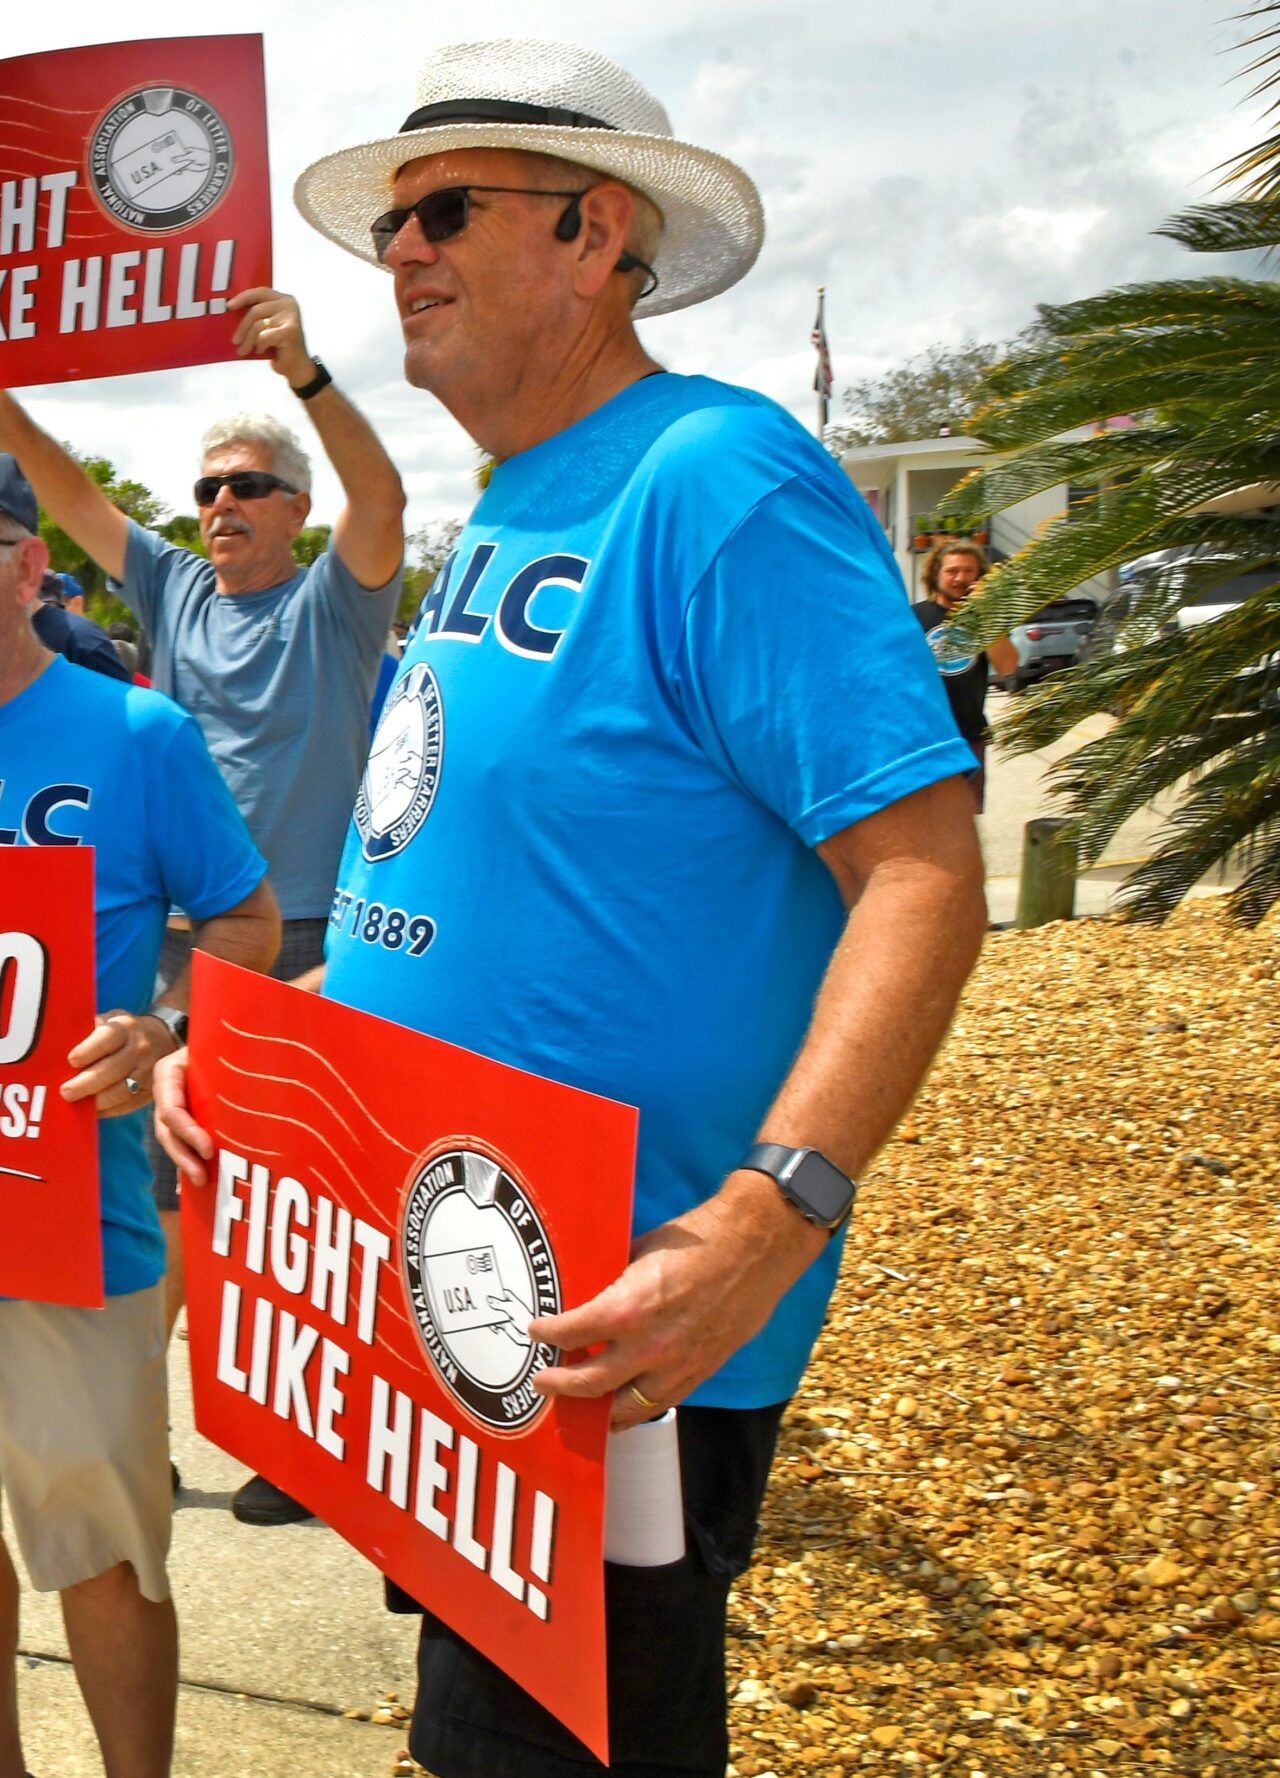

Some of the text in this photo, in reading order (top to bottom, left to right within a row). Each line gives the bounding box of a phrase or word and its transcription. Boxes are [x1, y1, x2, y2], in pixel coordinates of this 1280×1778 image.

[94, 99, 228, 225] NATIONAL ASSOCIATION OF LETTER CARRIERS
[59, 239, 236, 334] HELL!
[418, 542, 592, 661] ALC
[390, 774, 435, 846] CARRIERS
[351, 898, 438, 957] 1889
[212, 1148, 391, 1345] FIGHT
[407, 1162, 454, 1271] ASSOCIATION
[509, 1198, 532, 1227] OF
[527, 1238, 558, 1317] LETTE
[411, 1282, 458, 1384] NATIONAL
[216, 1280, 557, 1621] LIKE HELL!
